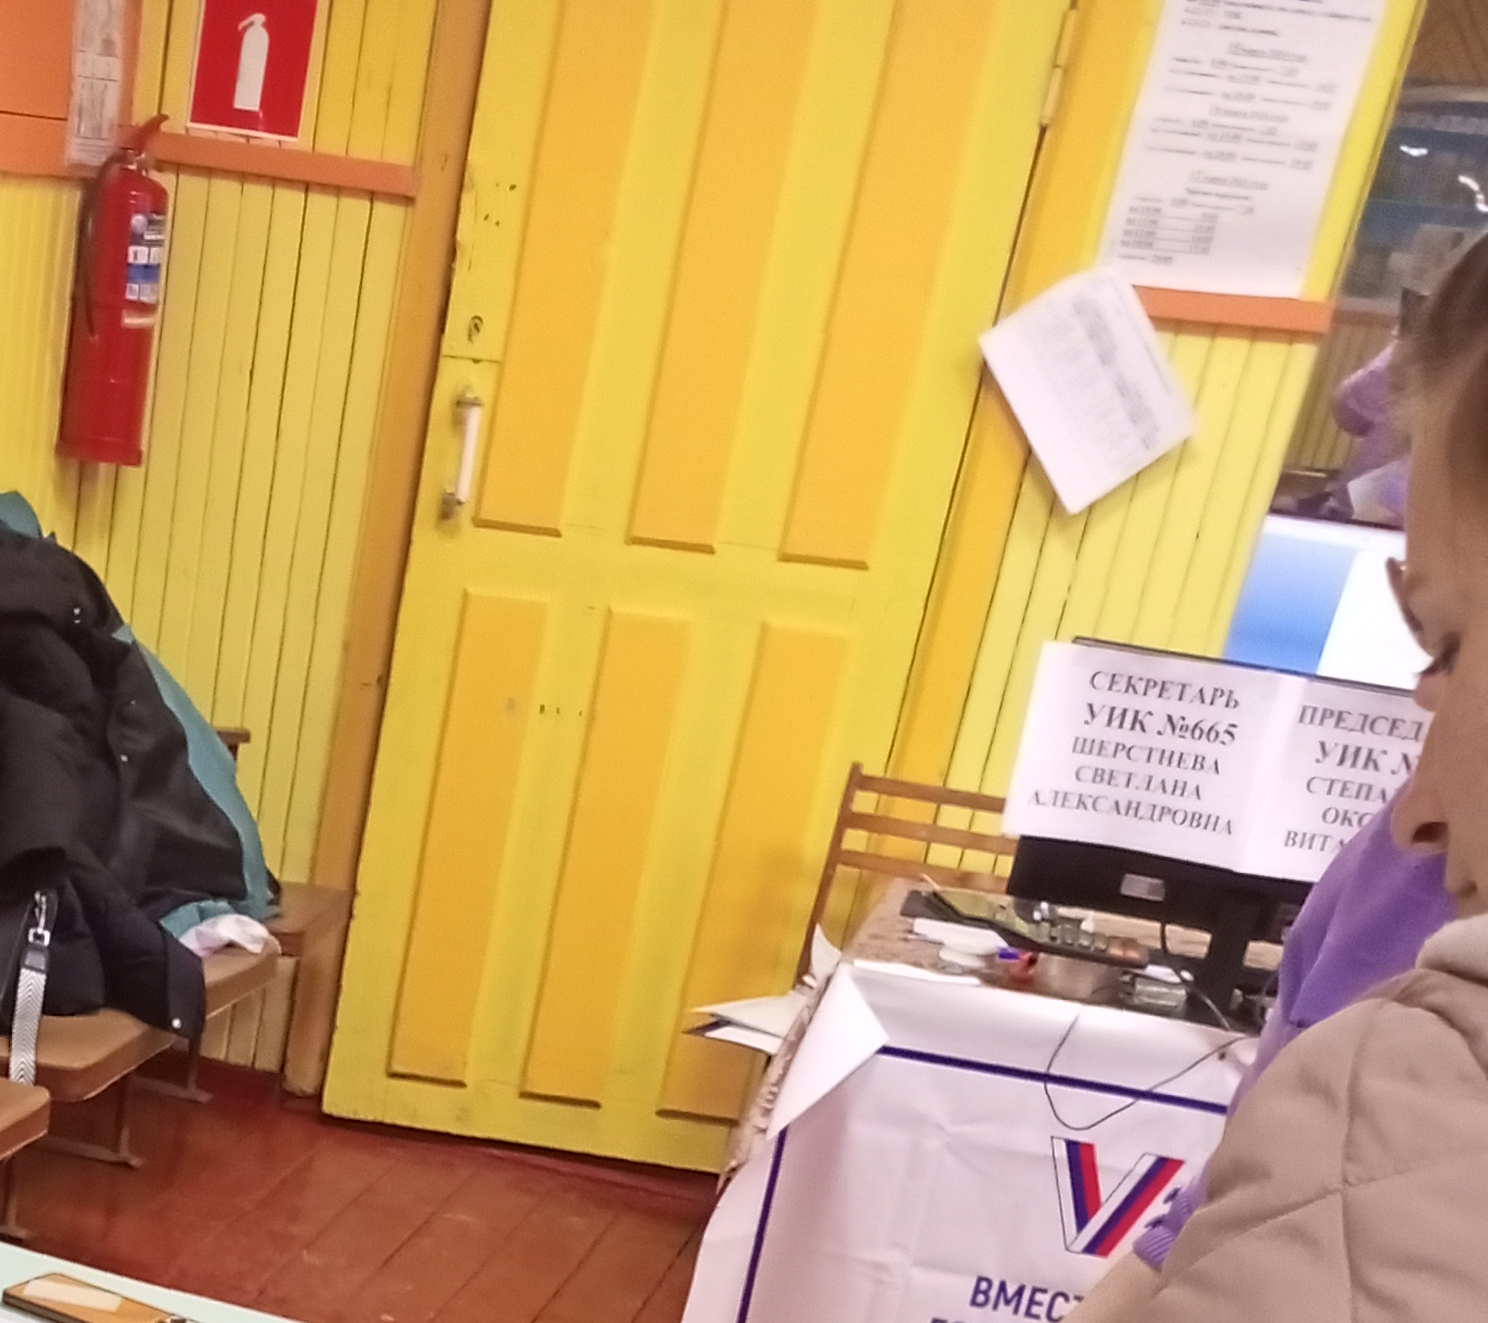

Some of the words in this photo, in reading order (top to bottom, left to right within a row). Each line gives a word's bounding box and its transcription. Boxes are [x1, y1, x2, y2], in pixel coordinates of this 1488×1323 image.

[1089, 670, 1240, 709] СЕКРЕТАРЬ
[1083, 702, 1154, 734] УИК
[1156, 712, 1239, 746] №665
[1297, 704, 1426, 743] ПРЕДСЕД
[1071, 735, 1221, 776] ШЕРСТНЕВА
[1314, 740, 1389, 773] УИК
[1074, 765, 1202, 801] СВЕТЛАНА
[1305, 775, 1400, 804] СТЕПА
[1028, 789, 1233, 836] АЛЕКСАНДРОВНА
[968, 1274, 1085, 1323] ВМЕС
